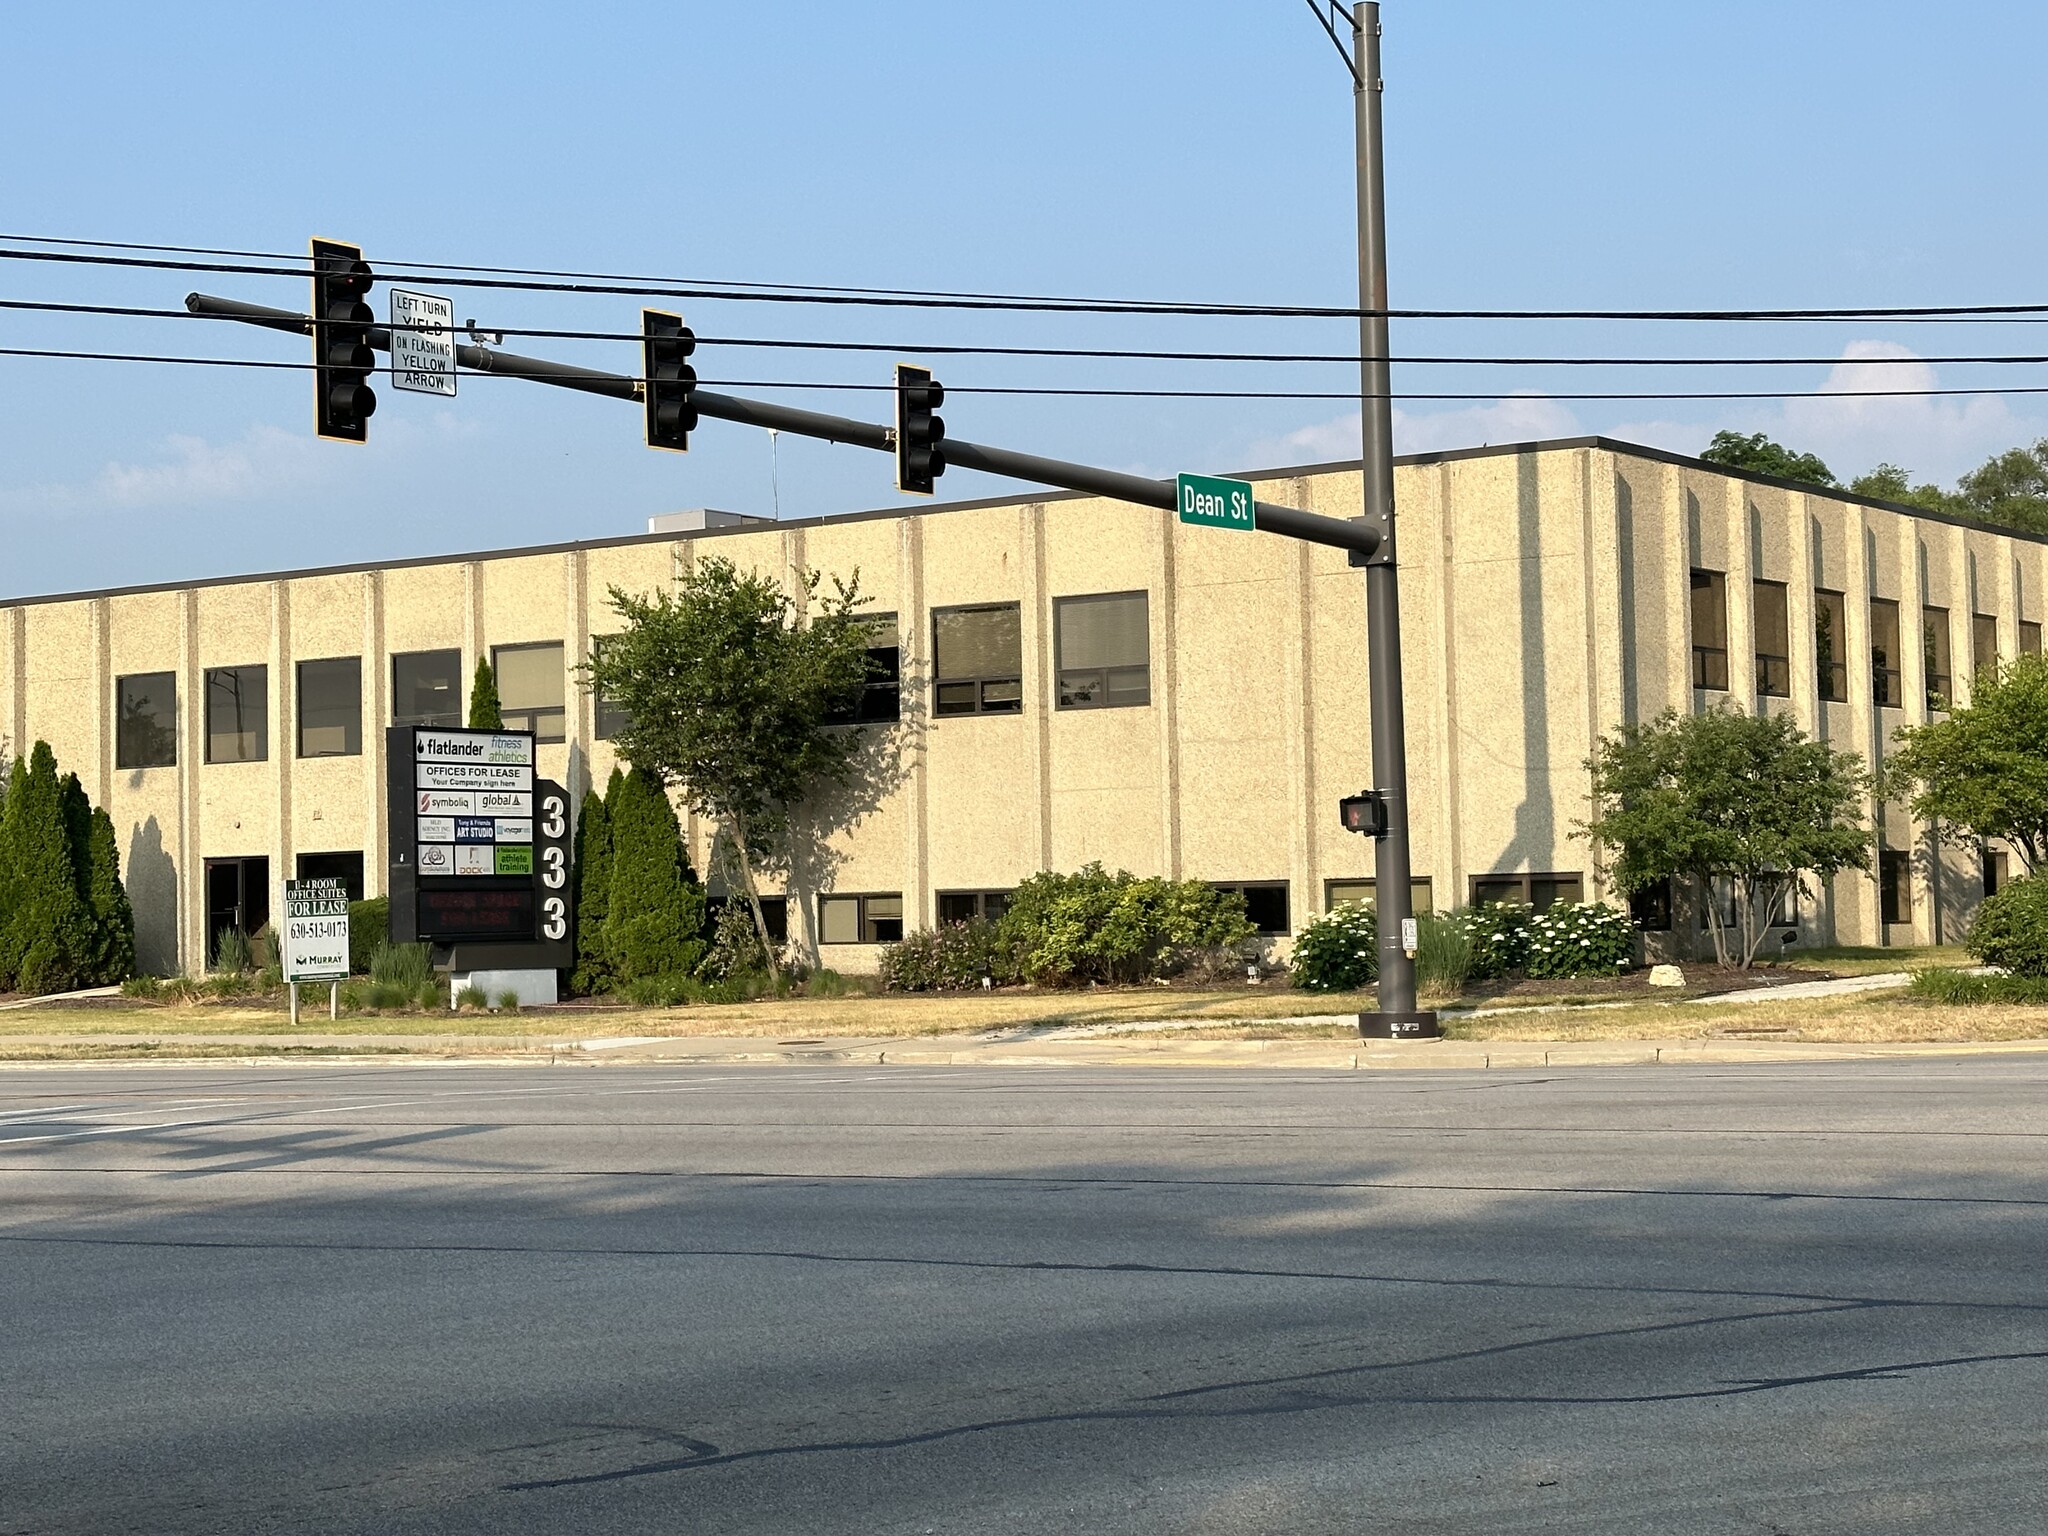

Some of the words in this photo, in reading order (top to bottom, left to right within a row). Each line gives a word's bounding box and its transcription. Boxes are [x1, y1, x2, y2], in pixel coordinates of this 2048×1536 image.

[397, 296, 419, 312] LEFT
[422, 301, 447, 317] TURN
[396, 336, 408, 349] ON
[411, 338, 450, 356] FLASHING
[402, 353, 446, 372] YELLOW
[405, 372, 445, 389] ARROW
[1184, 484, 1225, 517] Dean
[1231, 491, 1248, 520] St
[427, 739, 484, 756] flatlander
[491, 735, 522, 748] fitness
[488, 750, 528, 763] athletics
[426, 767, 466, 776] OFFICES
[469, 768, 488, 777] FOR
[490, 769, 521, 778] LEASE
[432, 778, 448, 786] Your
[449, 778, 482, 787] Company
[483, 779, 499, 787] sign
[500, 779, 516, 787] here
[432, 797, 469, 809] symboliq
[482, 794, 511, 808] global
[457, 827, 469, 837] ART
[470, 827, 493, 838] STUDIO
[500, 862, 529, 873] training
[311, 879, 337, 889] ROOM
[287, 889, 317, 900] OFFICE
[317, 888, 347, 898] SUITES
[288, 901, 311, 916] FOR
[312, 900, 347, 915] LEASE
[290, 921, 347, 939] 630-513-0173
